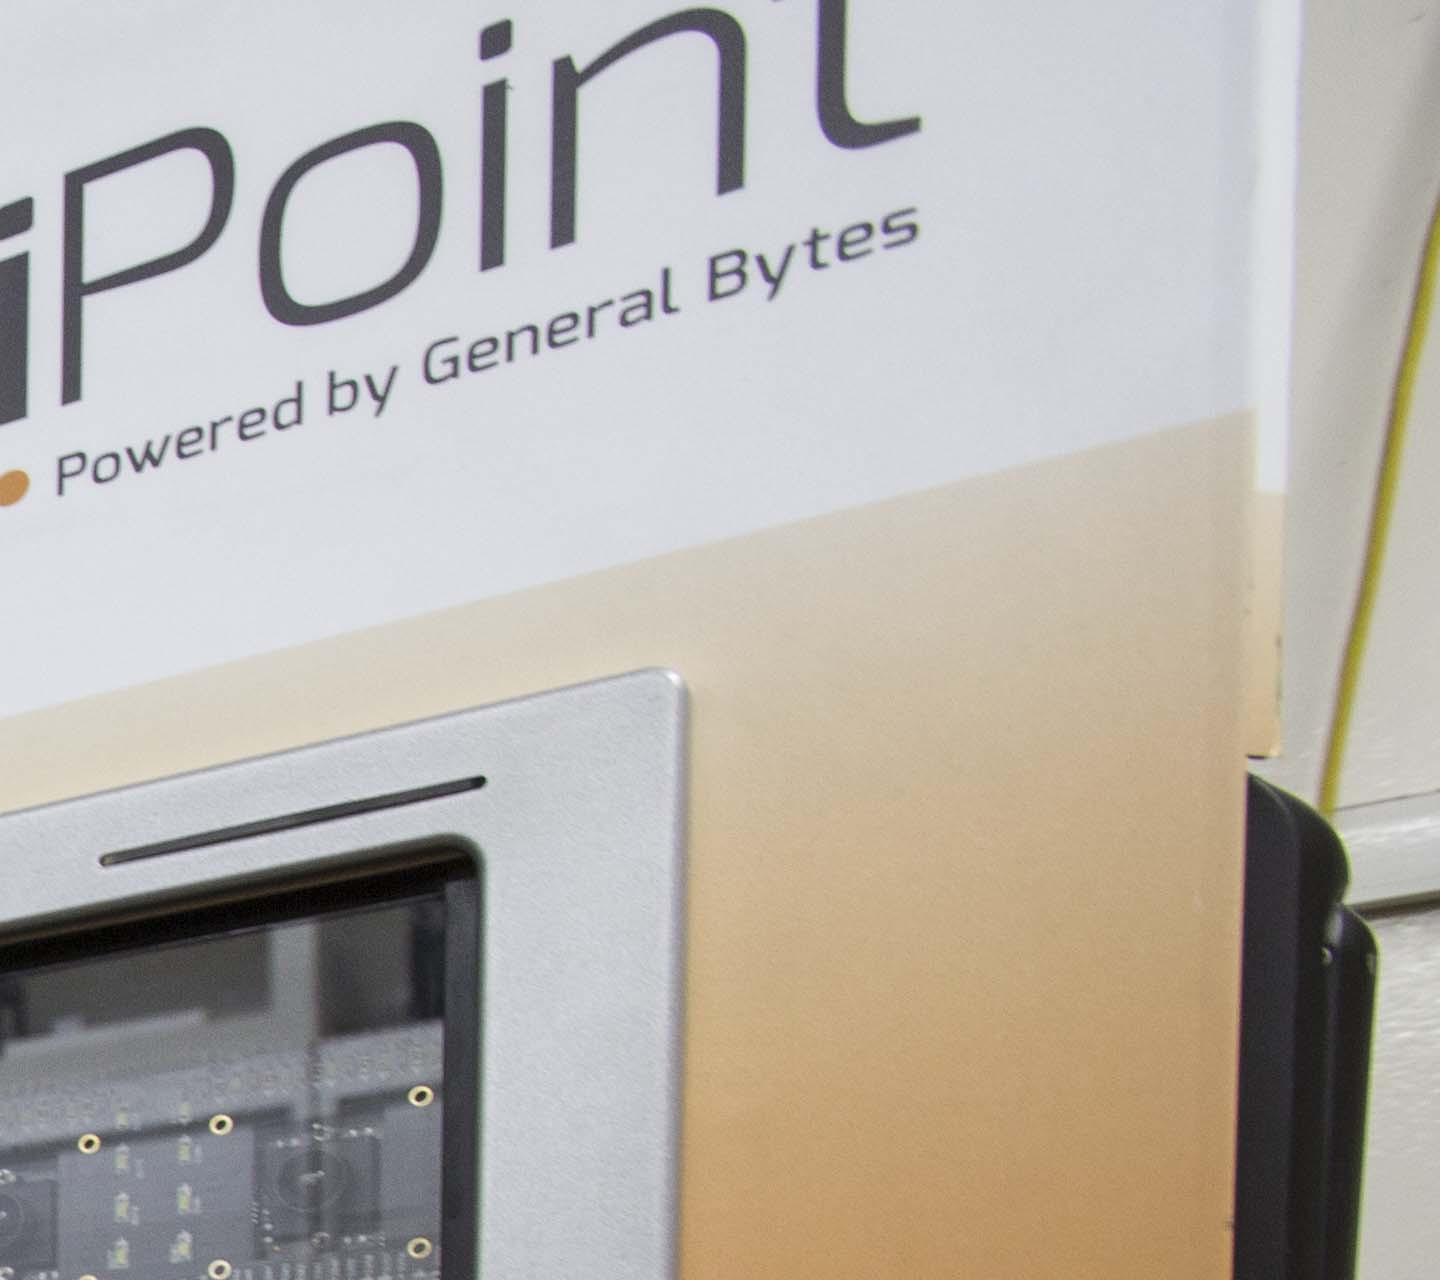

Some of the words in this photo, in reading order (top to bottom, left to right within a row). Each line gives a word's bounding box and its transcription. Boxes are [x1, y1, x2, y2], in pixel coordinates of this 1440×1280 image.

[57, 381, 303, 496] Powered
[328, 366, 398, 419] by
[423, 267, 679, 385] General
[709, 208, 919, 301] Bytes
